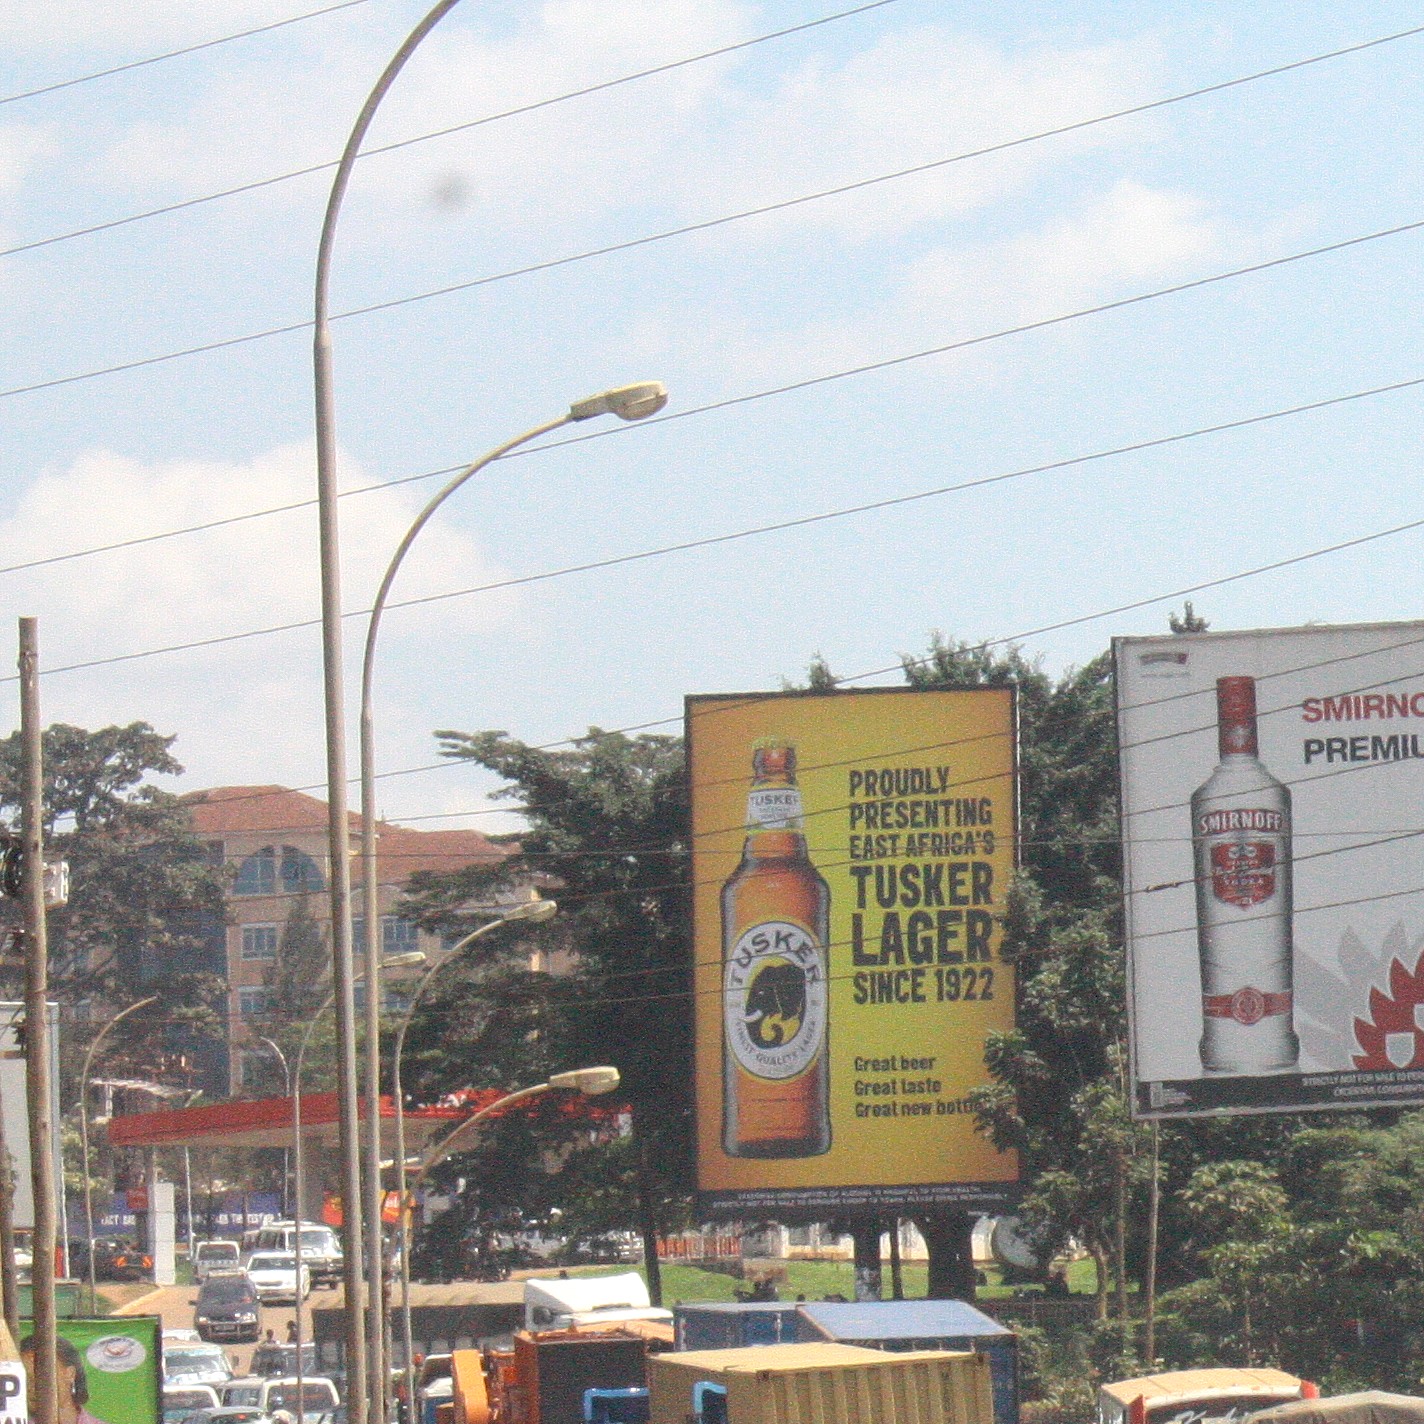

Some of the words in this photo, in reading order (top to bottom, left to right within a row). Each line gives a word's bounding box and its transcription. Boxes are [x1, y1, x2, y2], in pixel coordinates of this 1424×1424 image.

[850, 766, 950, 797] PROUDLY
[850, 797, 992, 830] PRESENTING
[1200, 811, 1283, 834] SMIRNOFF
[850, 834, 899, 860] EAST
[906, 830, 994, 857] AFRICA'S
[850, 862, 993, 908] TUSKER
[852, 909, 993, 966] LAGER
[730, 930, 823, 987] TUSKER
[853, 968, 926, 1004] SINCE
[935, 967, 994, 1001] 1922
[855, 1055, 897, 1072] Great
[901, 1056, 935, 1070] beer
[855, 1080, 897, 1096] Great
[902, 1077, 941, 1093] taste
[856, 1101, 897, 1117] Great
[901, 1102, 932, 1115] new
